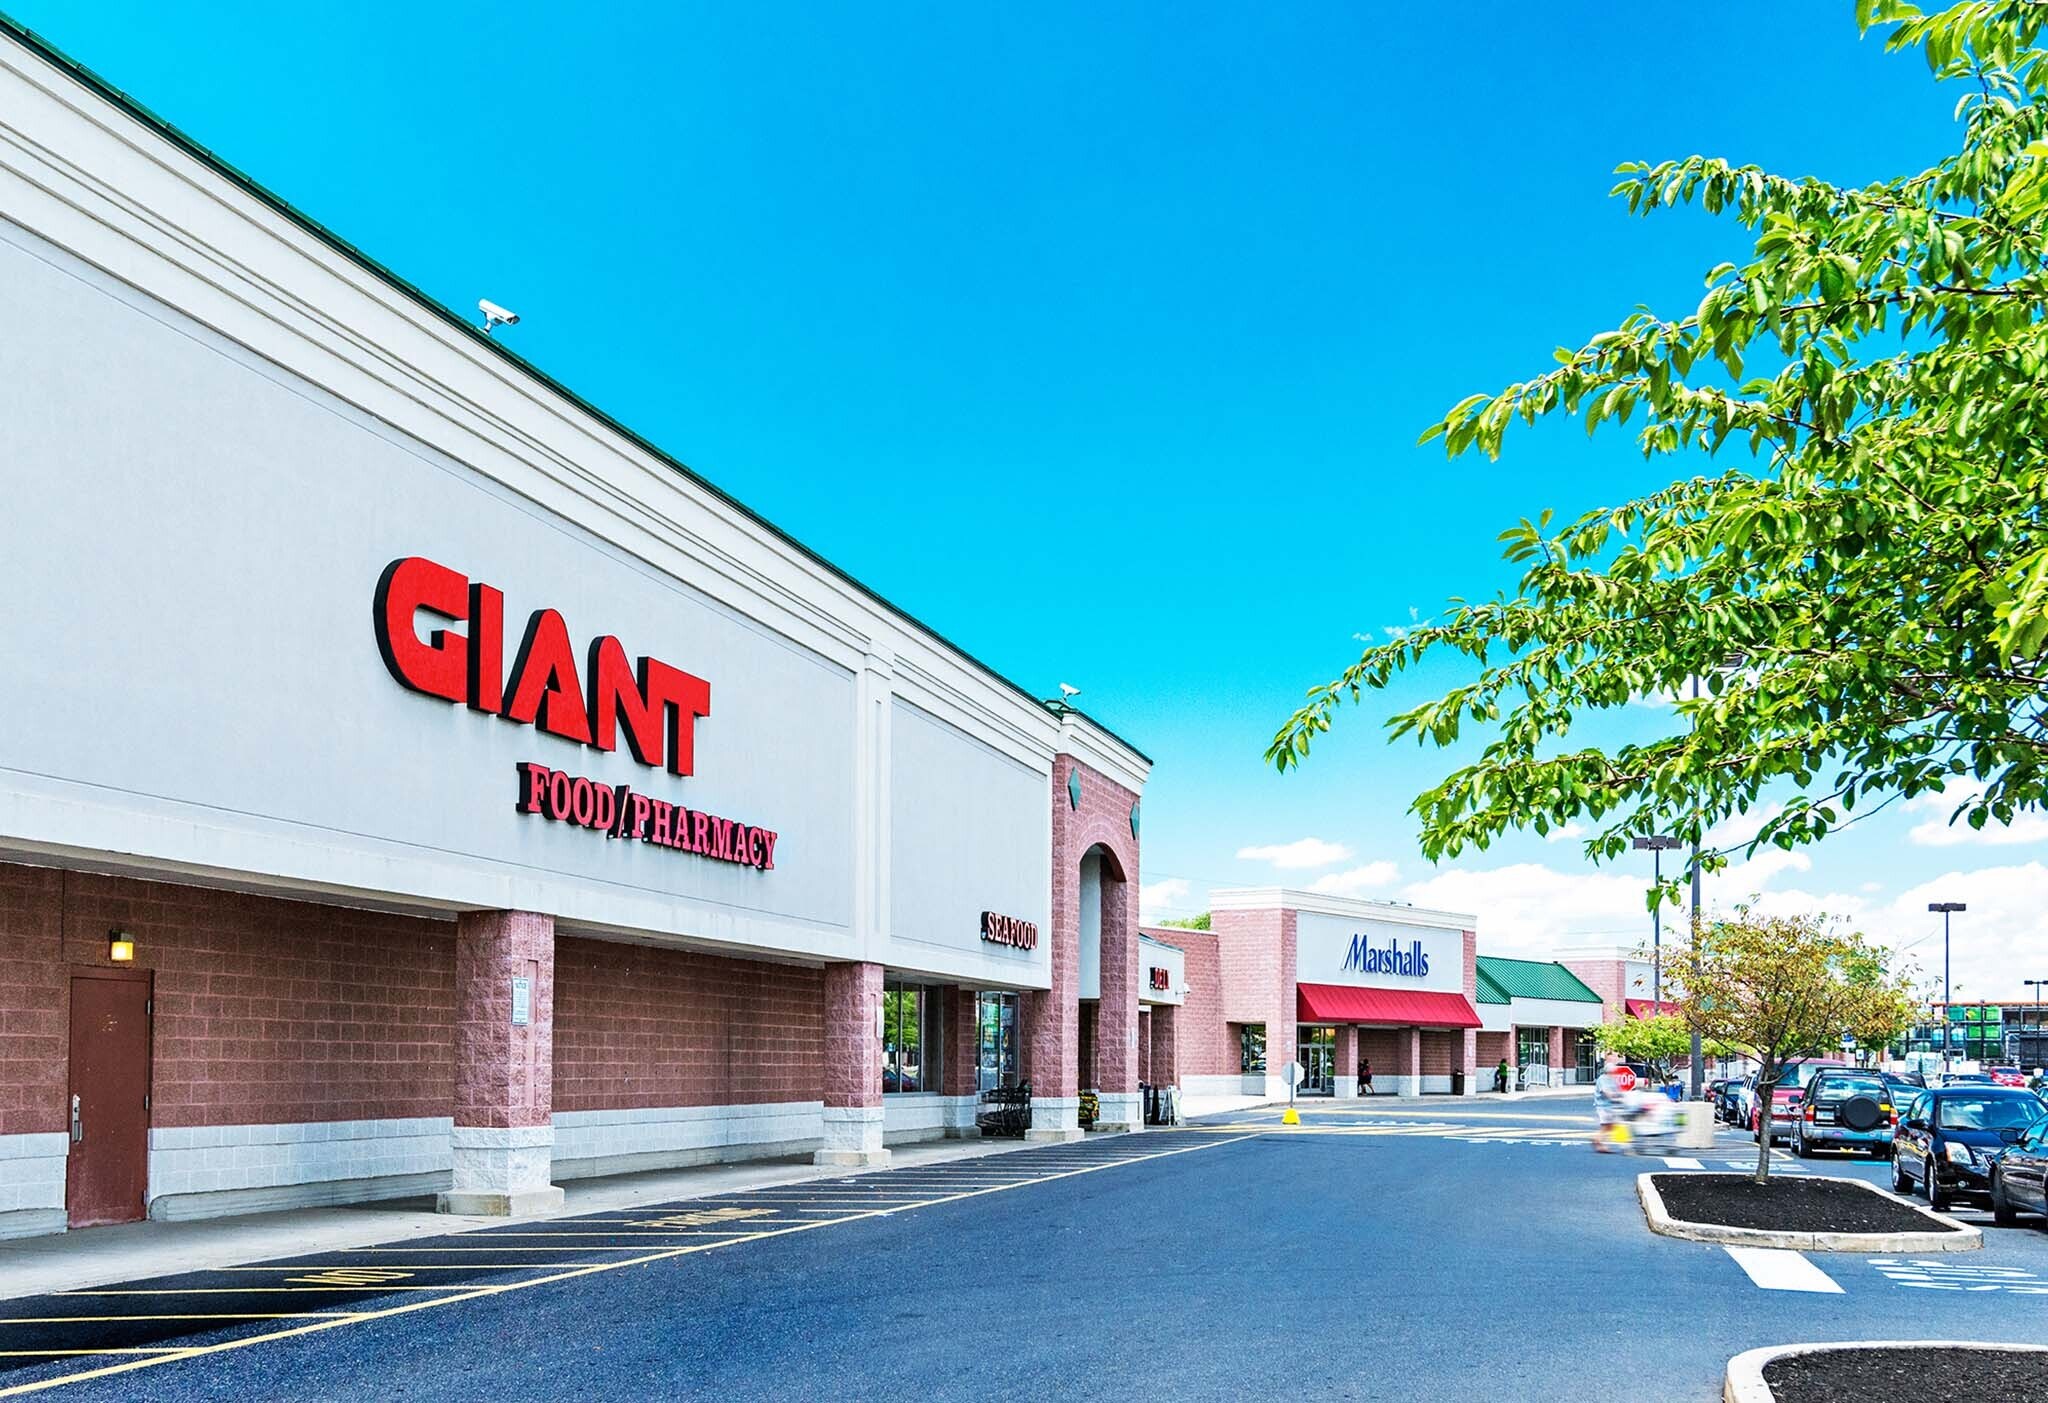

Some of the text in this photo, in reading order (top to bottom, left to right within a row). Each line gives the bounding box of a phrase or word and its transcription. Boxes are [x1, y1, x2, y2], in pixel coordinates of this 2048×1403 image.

[373, 556, 711, 777] GIANT
[516, 762, 777, 871] FOOD/PHARMACY
[982, 910, 1038, 951] SEAFOOD
[1342, 932, 1429, 977] Marshalls
